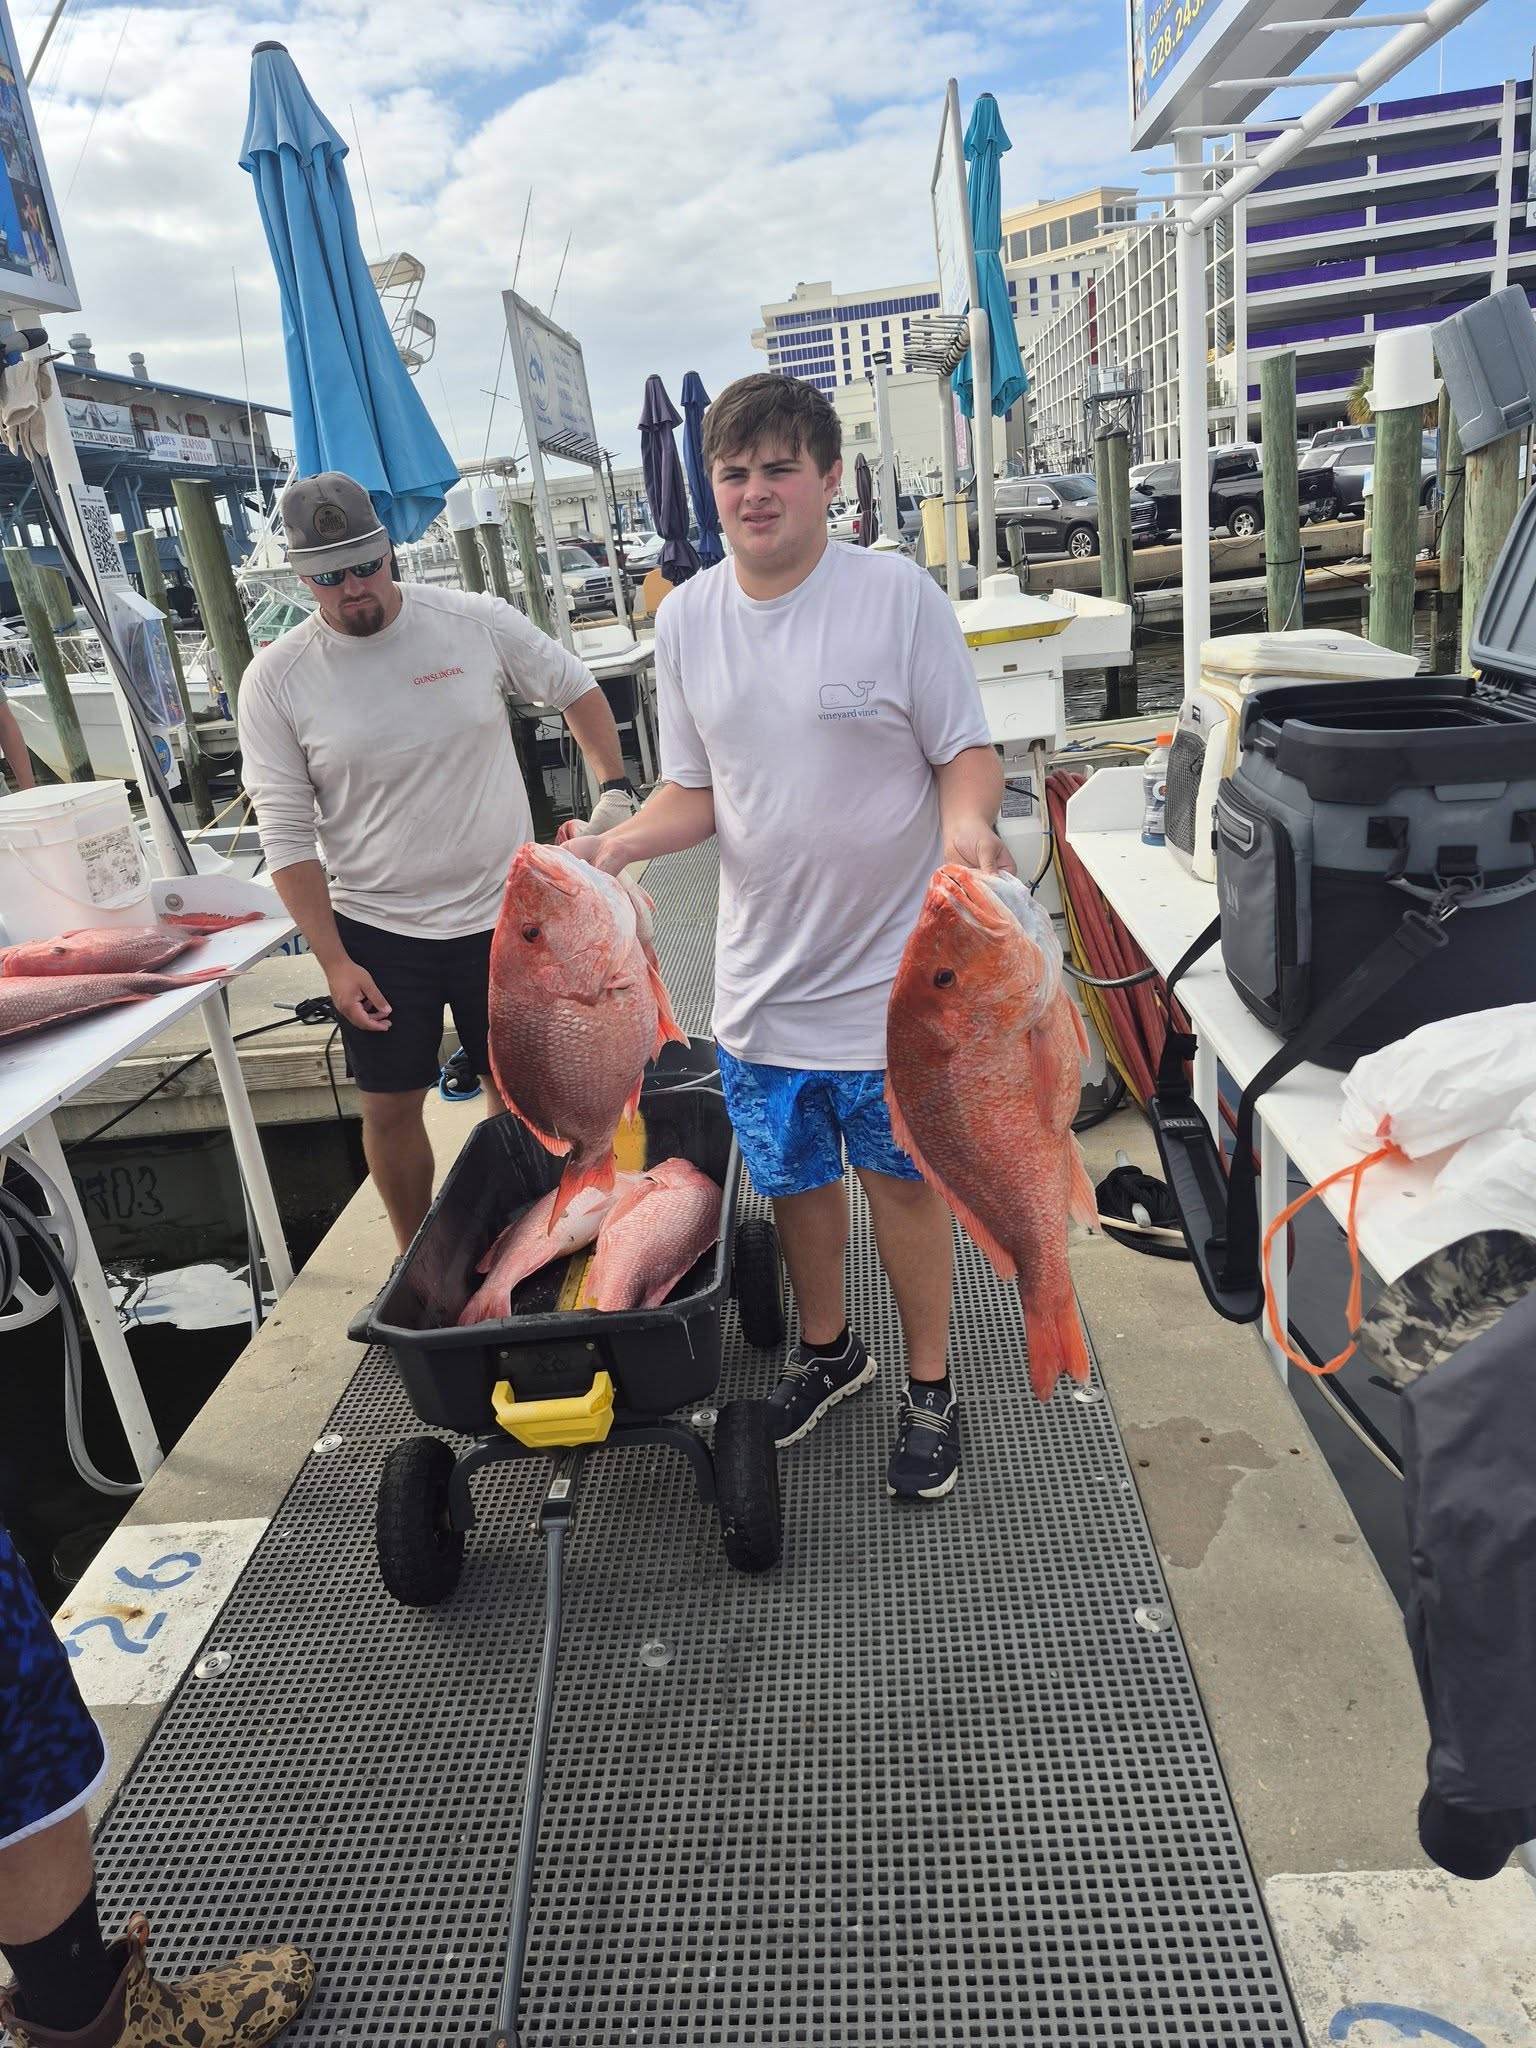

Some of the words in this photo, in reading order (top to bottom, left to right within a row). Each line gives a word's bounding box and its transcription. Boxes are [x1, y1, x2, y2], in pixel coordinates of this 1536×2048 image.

[413, 667, 465, 686] GUNSLINGER
[818, 709, 857, 720] vineyard
[857, 709, 878, 717] vines
